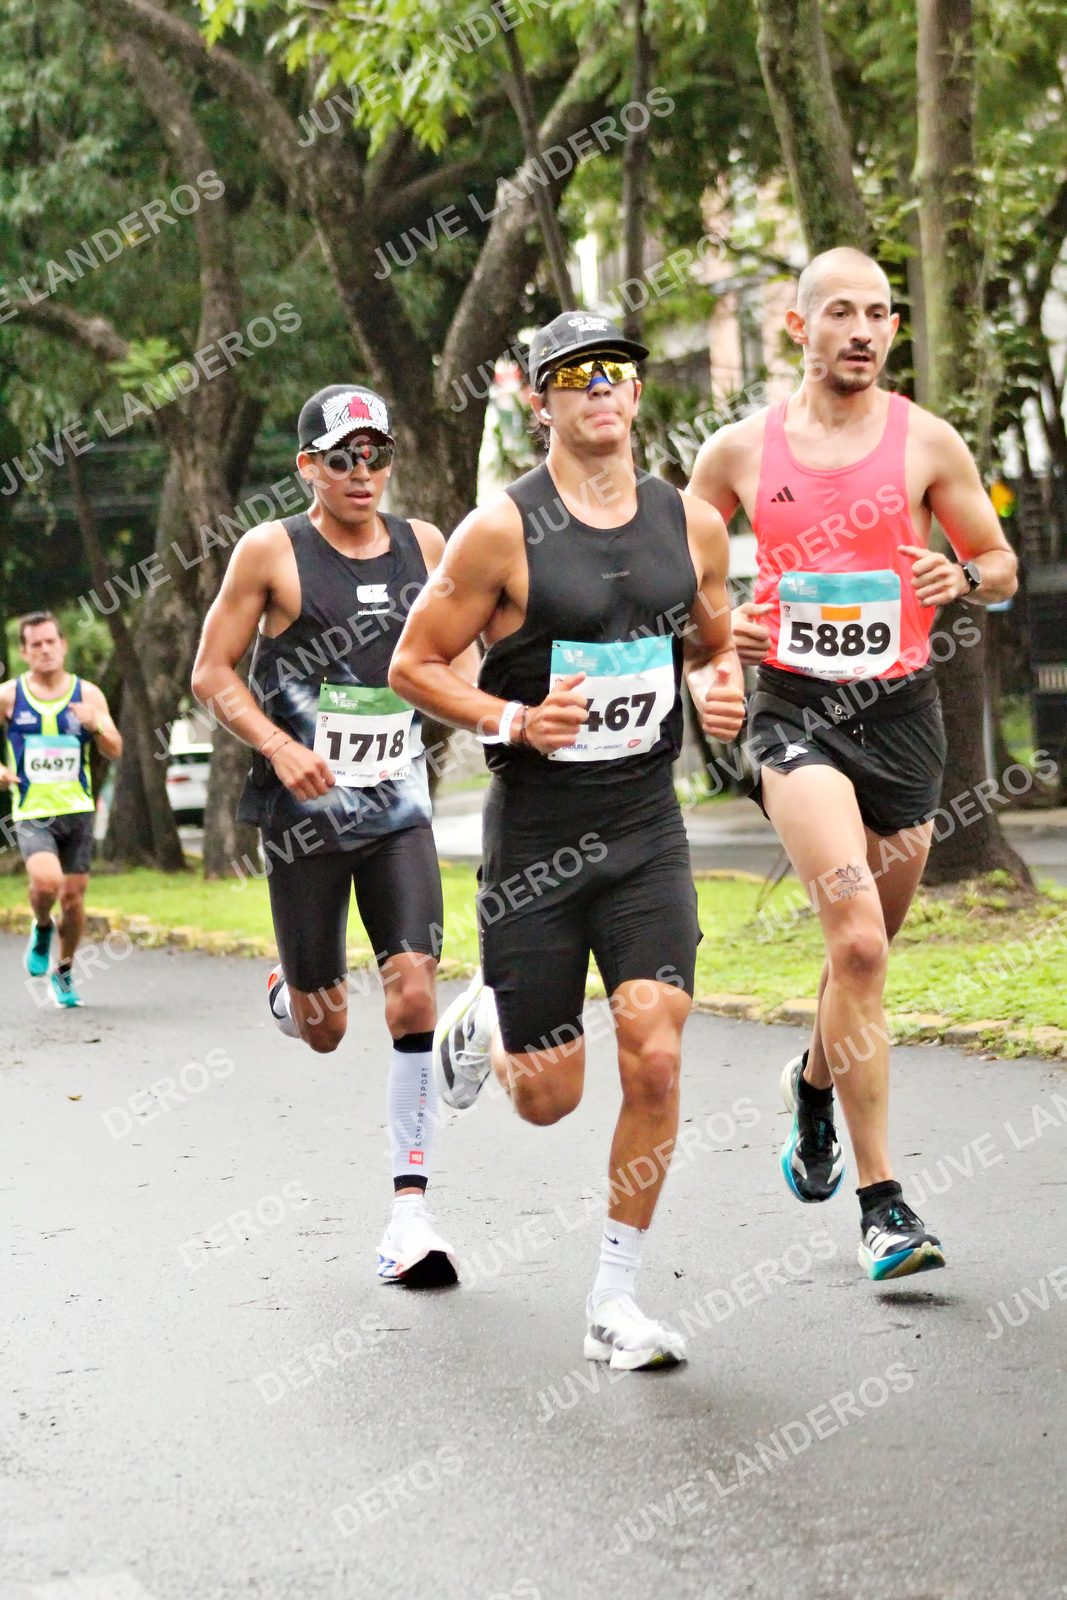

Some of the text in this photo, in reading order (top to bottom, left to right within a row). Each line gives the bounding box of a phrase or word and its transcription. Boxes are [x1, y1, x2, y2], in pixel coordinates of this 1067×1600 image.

[788, 621, 891, 657] 5889
[327, 729, 405, 763] 1718
[31, 757, 76, 771] 6497
